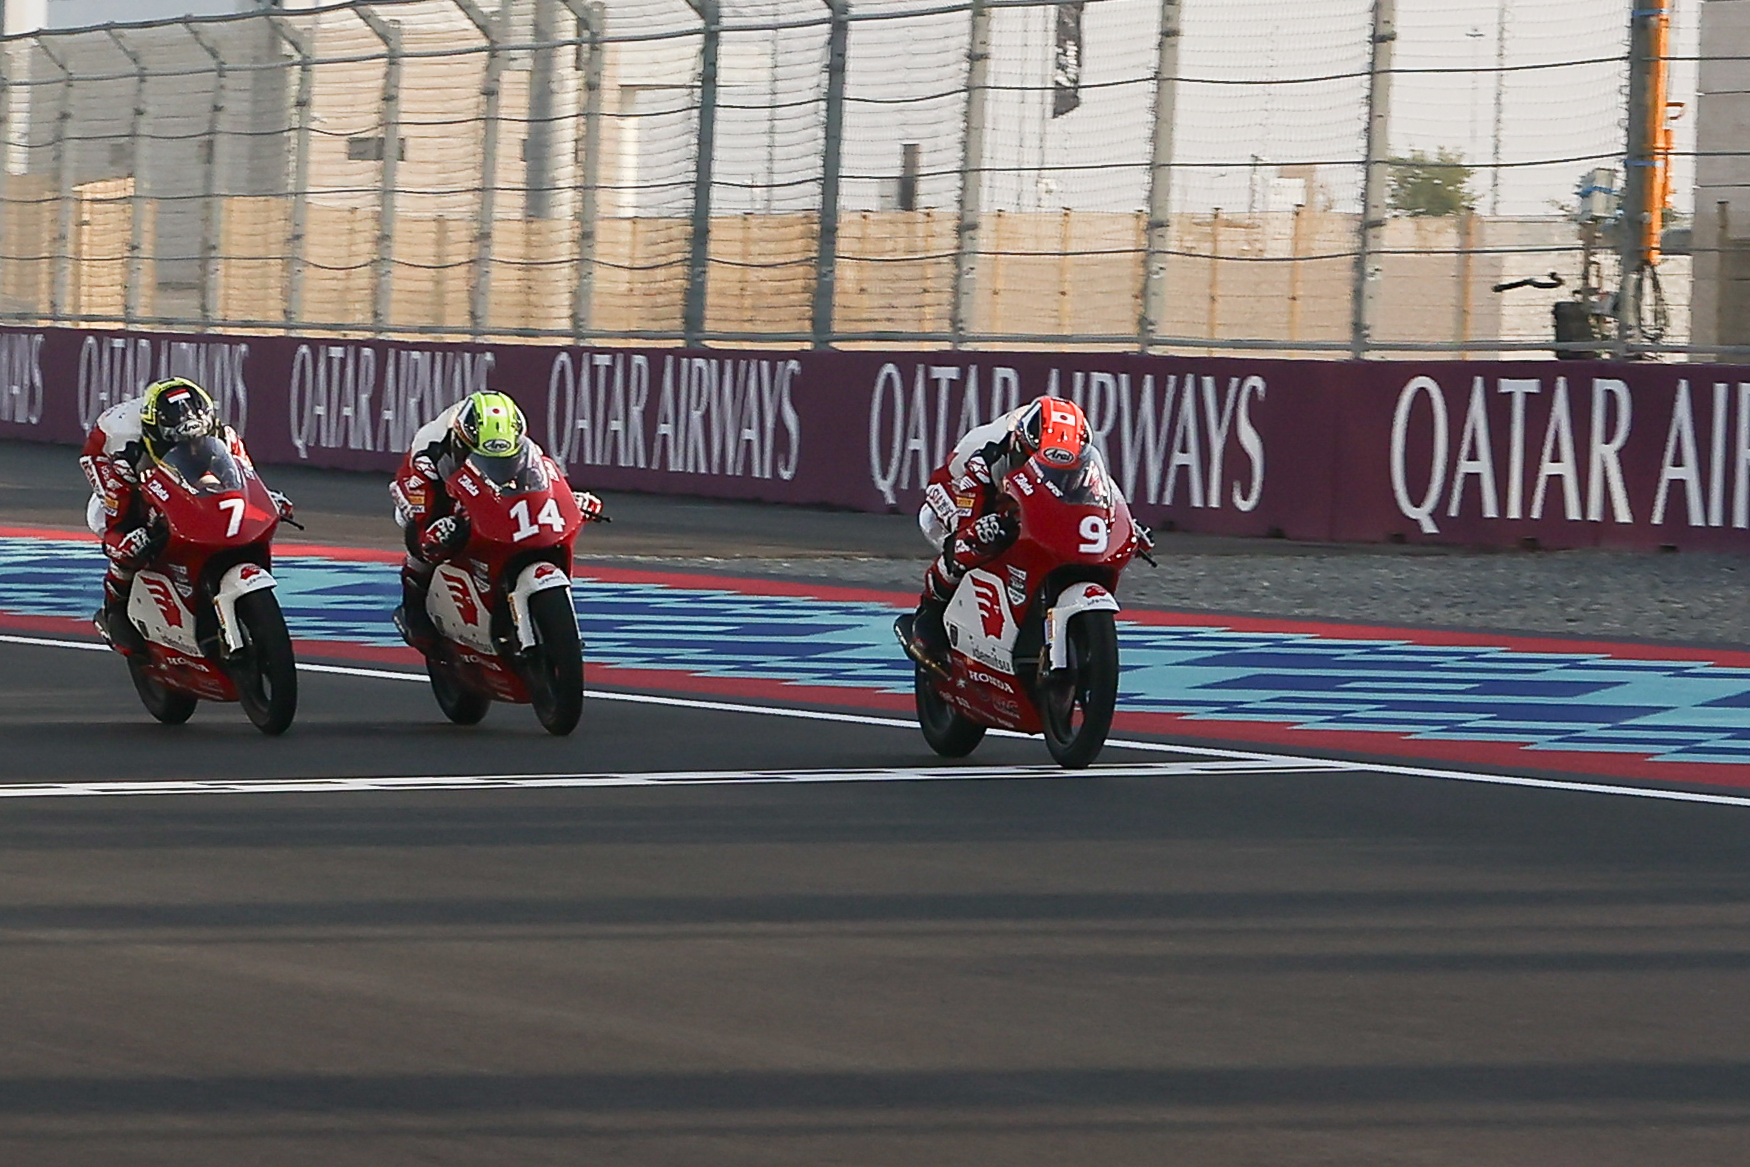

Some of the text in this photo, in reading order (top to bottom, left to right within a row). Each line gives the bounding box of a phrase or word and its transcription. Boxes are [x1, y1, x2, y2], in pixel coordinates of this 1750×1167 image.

[290, 345, 376, 459] QATAR
[547, 352, 801, 480] QATAR AIRWAYS
[1045, 368, 1267, 512] RWAYS
[1045, 447, 1074, 463] Arai
[1390, 376, 1634, 534] QATAR
[219, 498, 245, 538] 7
[509, 497, 566, 543] 14
[1078, 515, 1108, 553] 9
[968, 669, 1014, 694] HONDA
